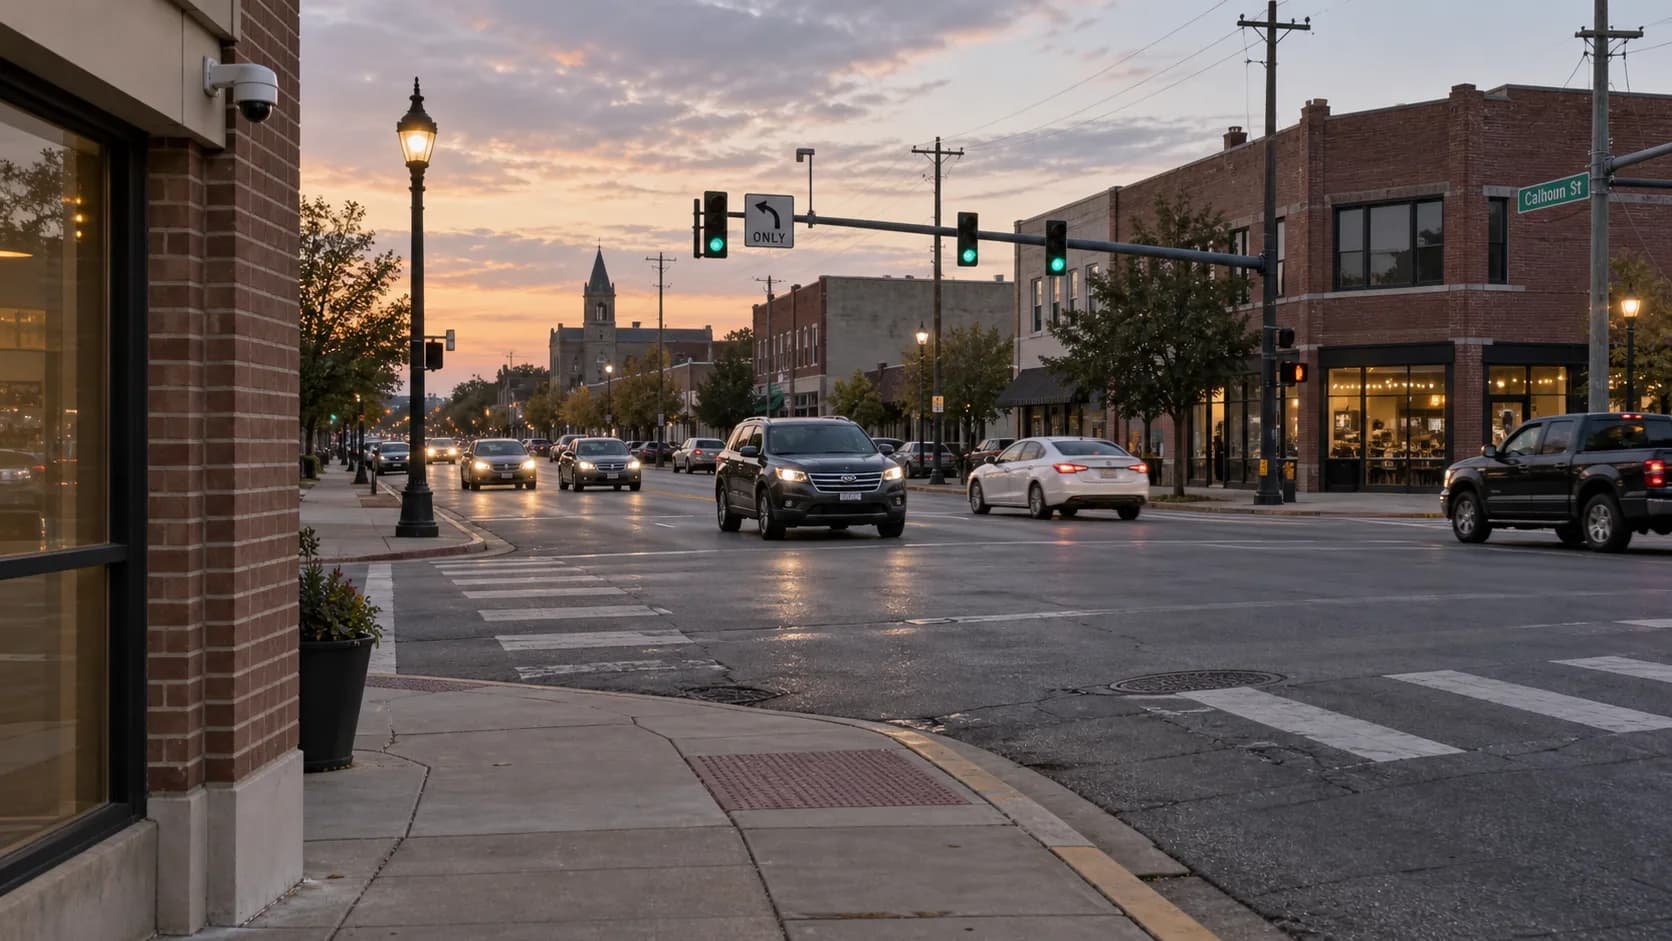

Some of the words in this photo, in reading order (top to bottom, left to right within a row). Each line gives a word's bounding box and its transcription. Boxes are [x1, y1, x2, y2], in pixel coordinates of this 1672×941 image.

[1525, 187, 1566, 206] Calhoun
[1570, 180, 1581, 195] St
[753, 231, 786, 243] ONLY
